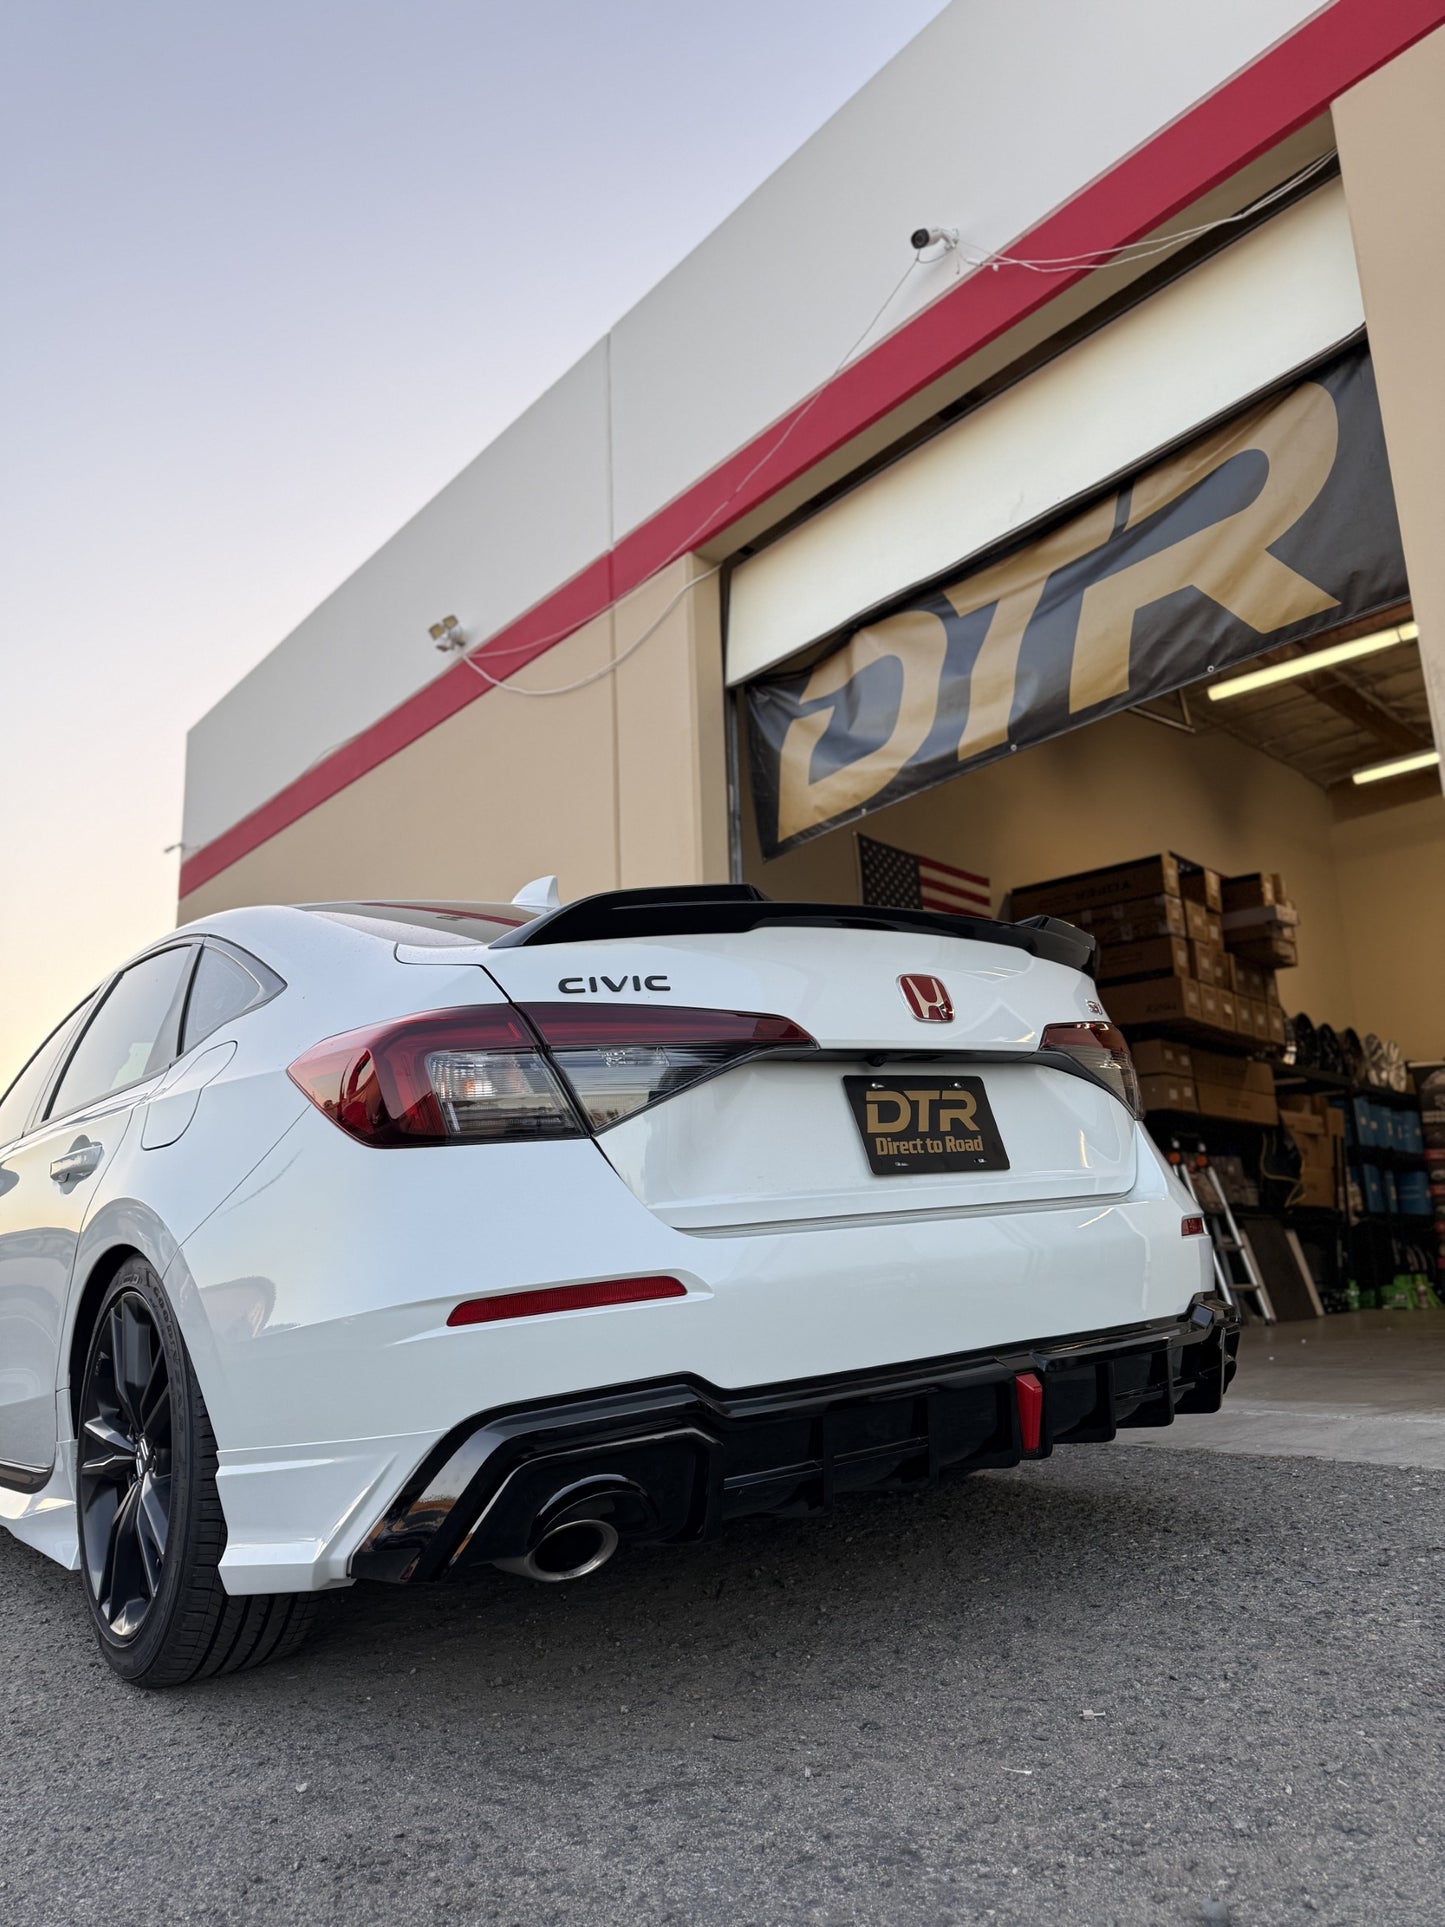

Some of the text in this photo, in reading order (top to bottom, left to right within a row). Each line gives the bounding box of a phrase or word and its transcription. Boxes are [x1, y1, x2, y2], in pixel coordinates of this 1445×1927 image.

[776, 380, 1342, 842] DTR
[557, 975, 671, 994] CIVIC
[865, 1089, 981, 1133] DTR
[875, 1135, 984, 1155] Direct to Road
